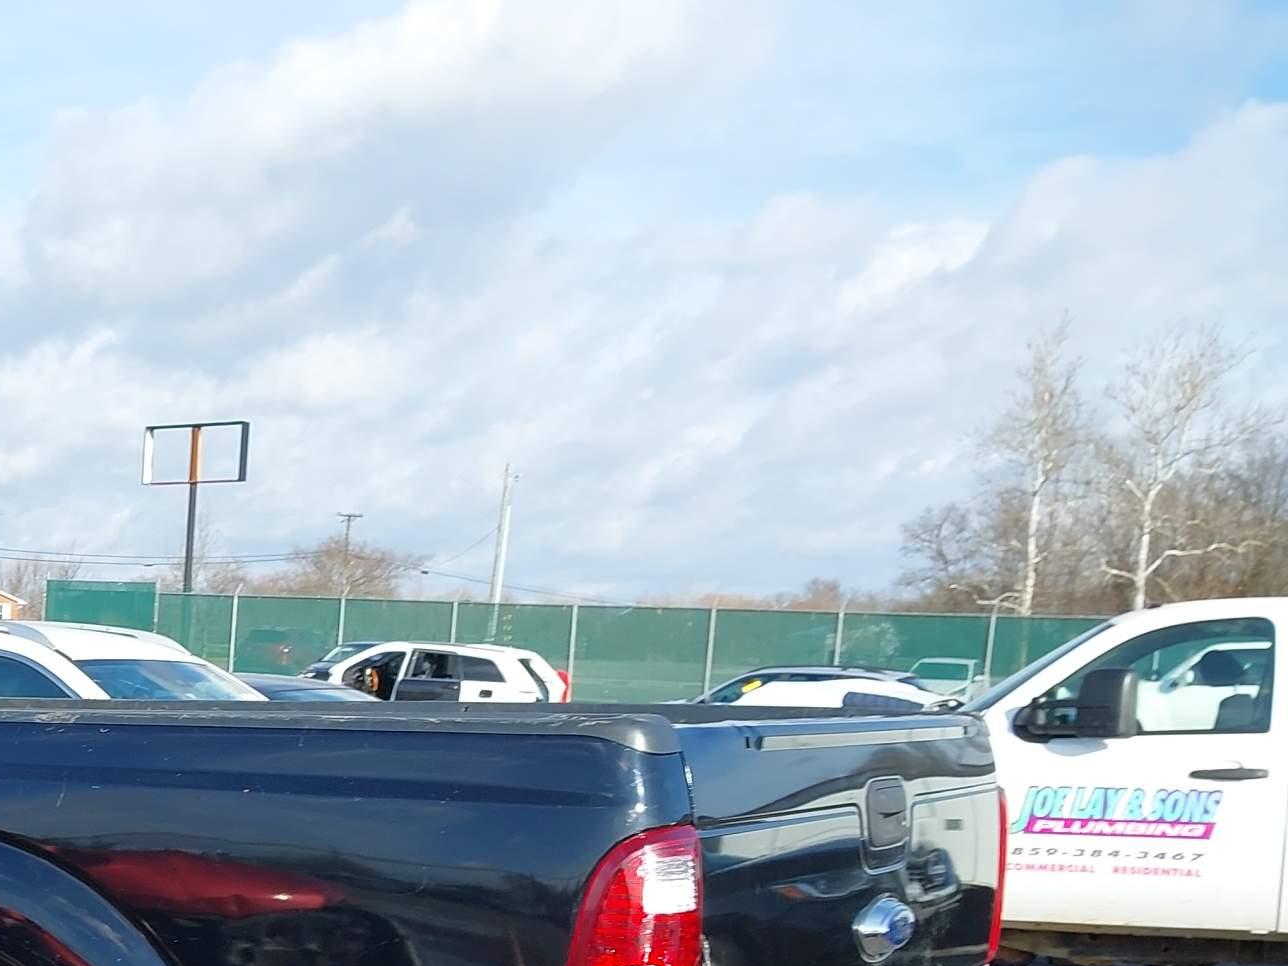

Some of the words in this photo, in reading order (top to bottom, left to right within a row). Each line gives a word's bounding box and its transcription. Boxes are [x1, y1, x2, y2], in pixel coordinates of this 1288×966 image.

[1008, 785, 1073, 834] JOE
[1072, 786, 1128, 821] LAY
[1124, 788, 1146, 821] &
[1148, 788, 1224, 824] SONS
[1030, 819, 1209, 838] PLUMBING
[1010, 847, 1207, 862] 859-384-3467
[1112, 864, 1202, 878] RESIDENTIAL
